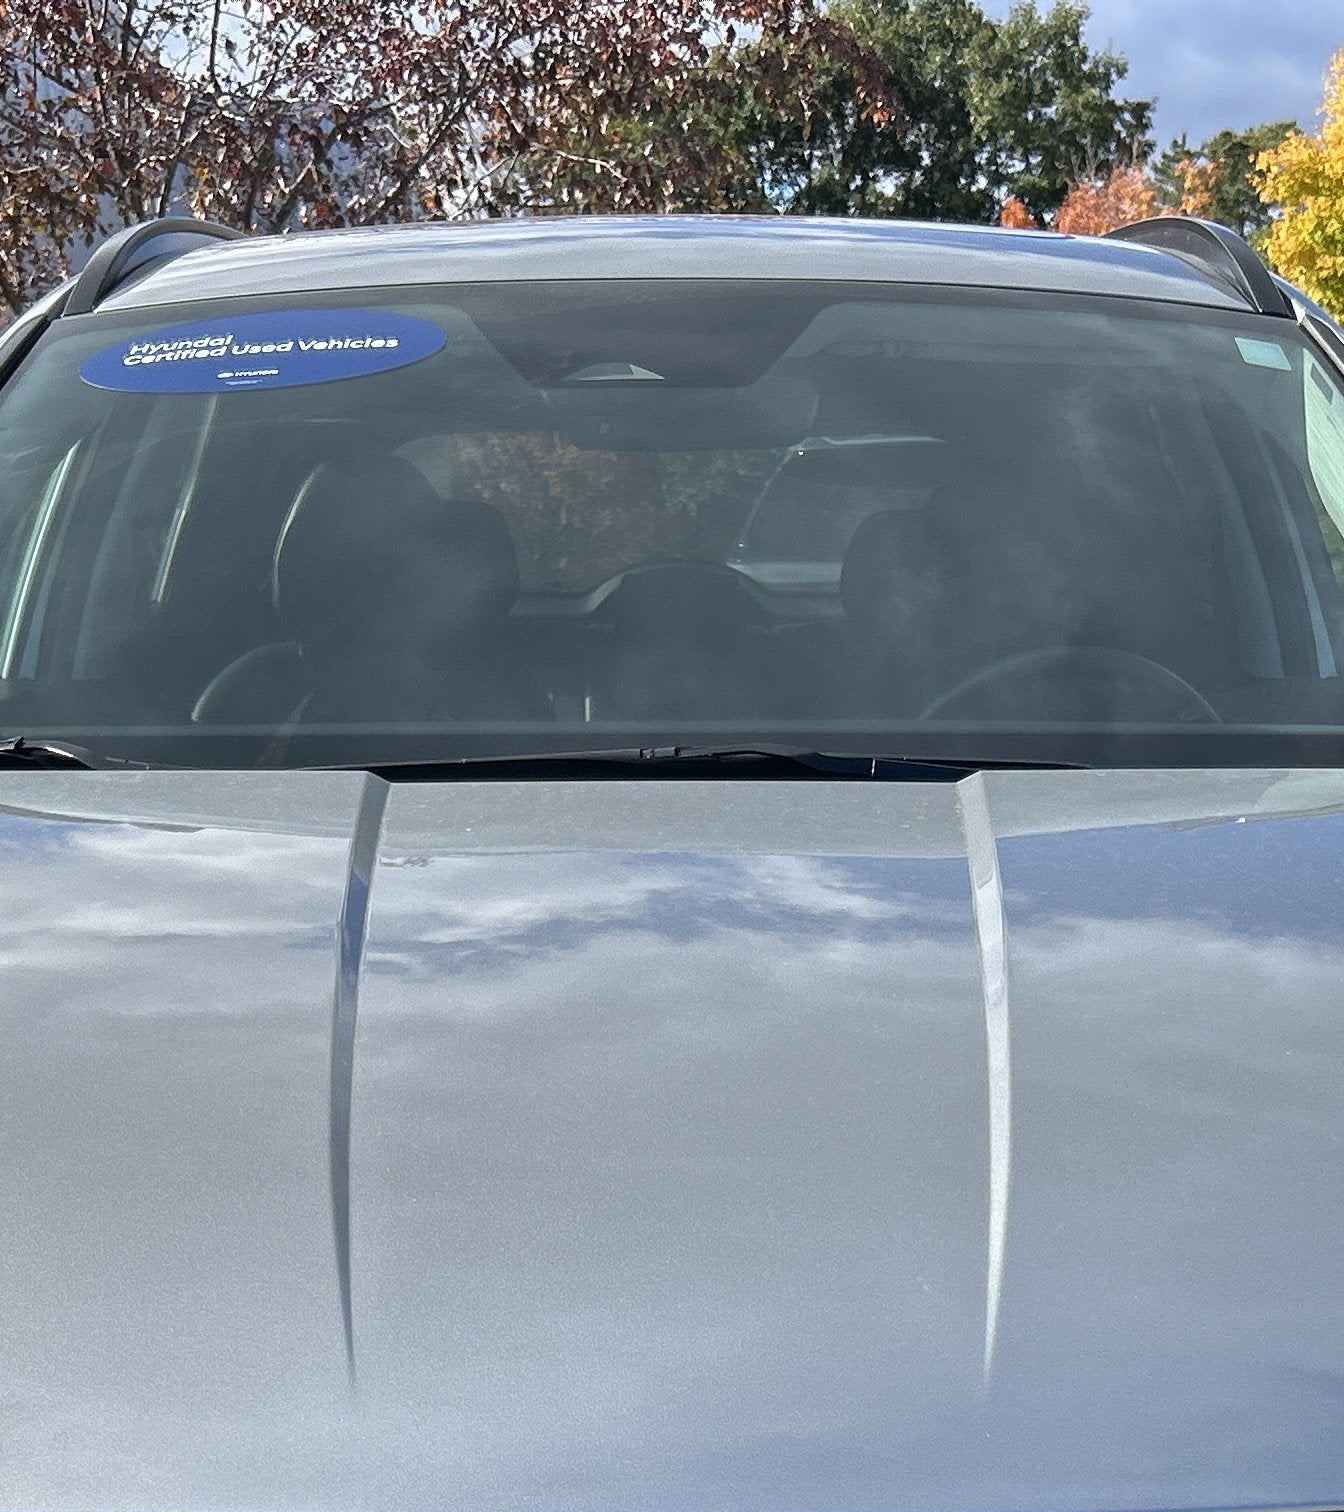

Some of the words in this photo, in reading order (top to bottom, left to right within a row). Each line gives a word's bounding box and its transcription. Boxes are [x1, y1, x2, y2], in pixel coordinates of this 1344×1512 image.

[123, 346, 228, 366] Certified
[231, 341, 294, 355] Used
[298, 337, 399, 351] Vehicles
[130, 334, 233, 355] Hyundai
